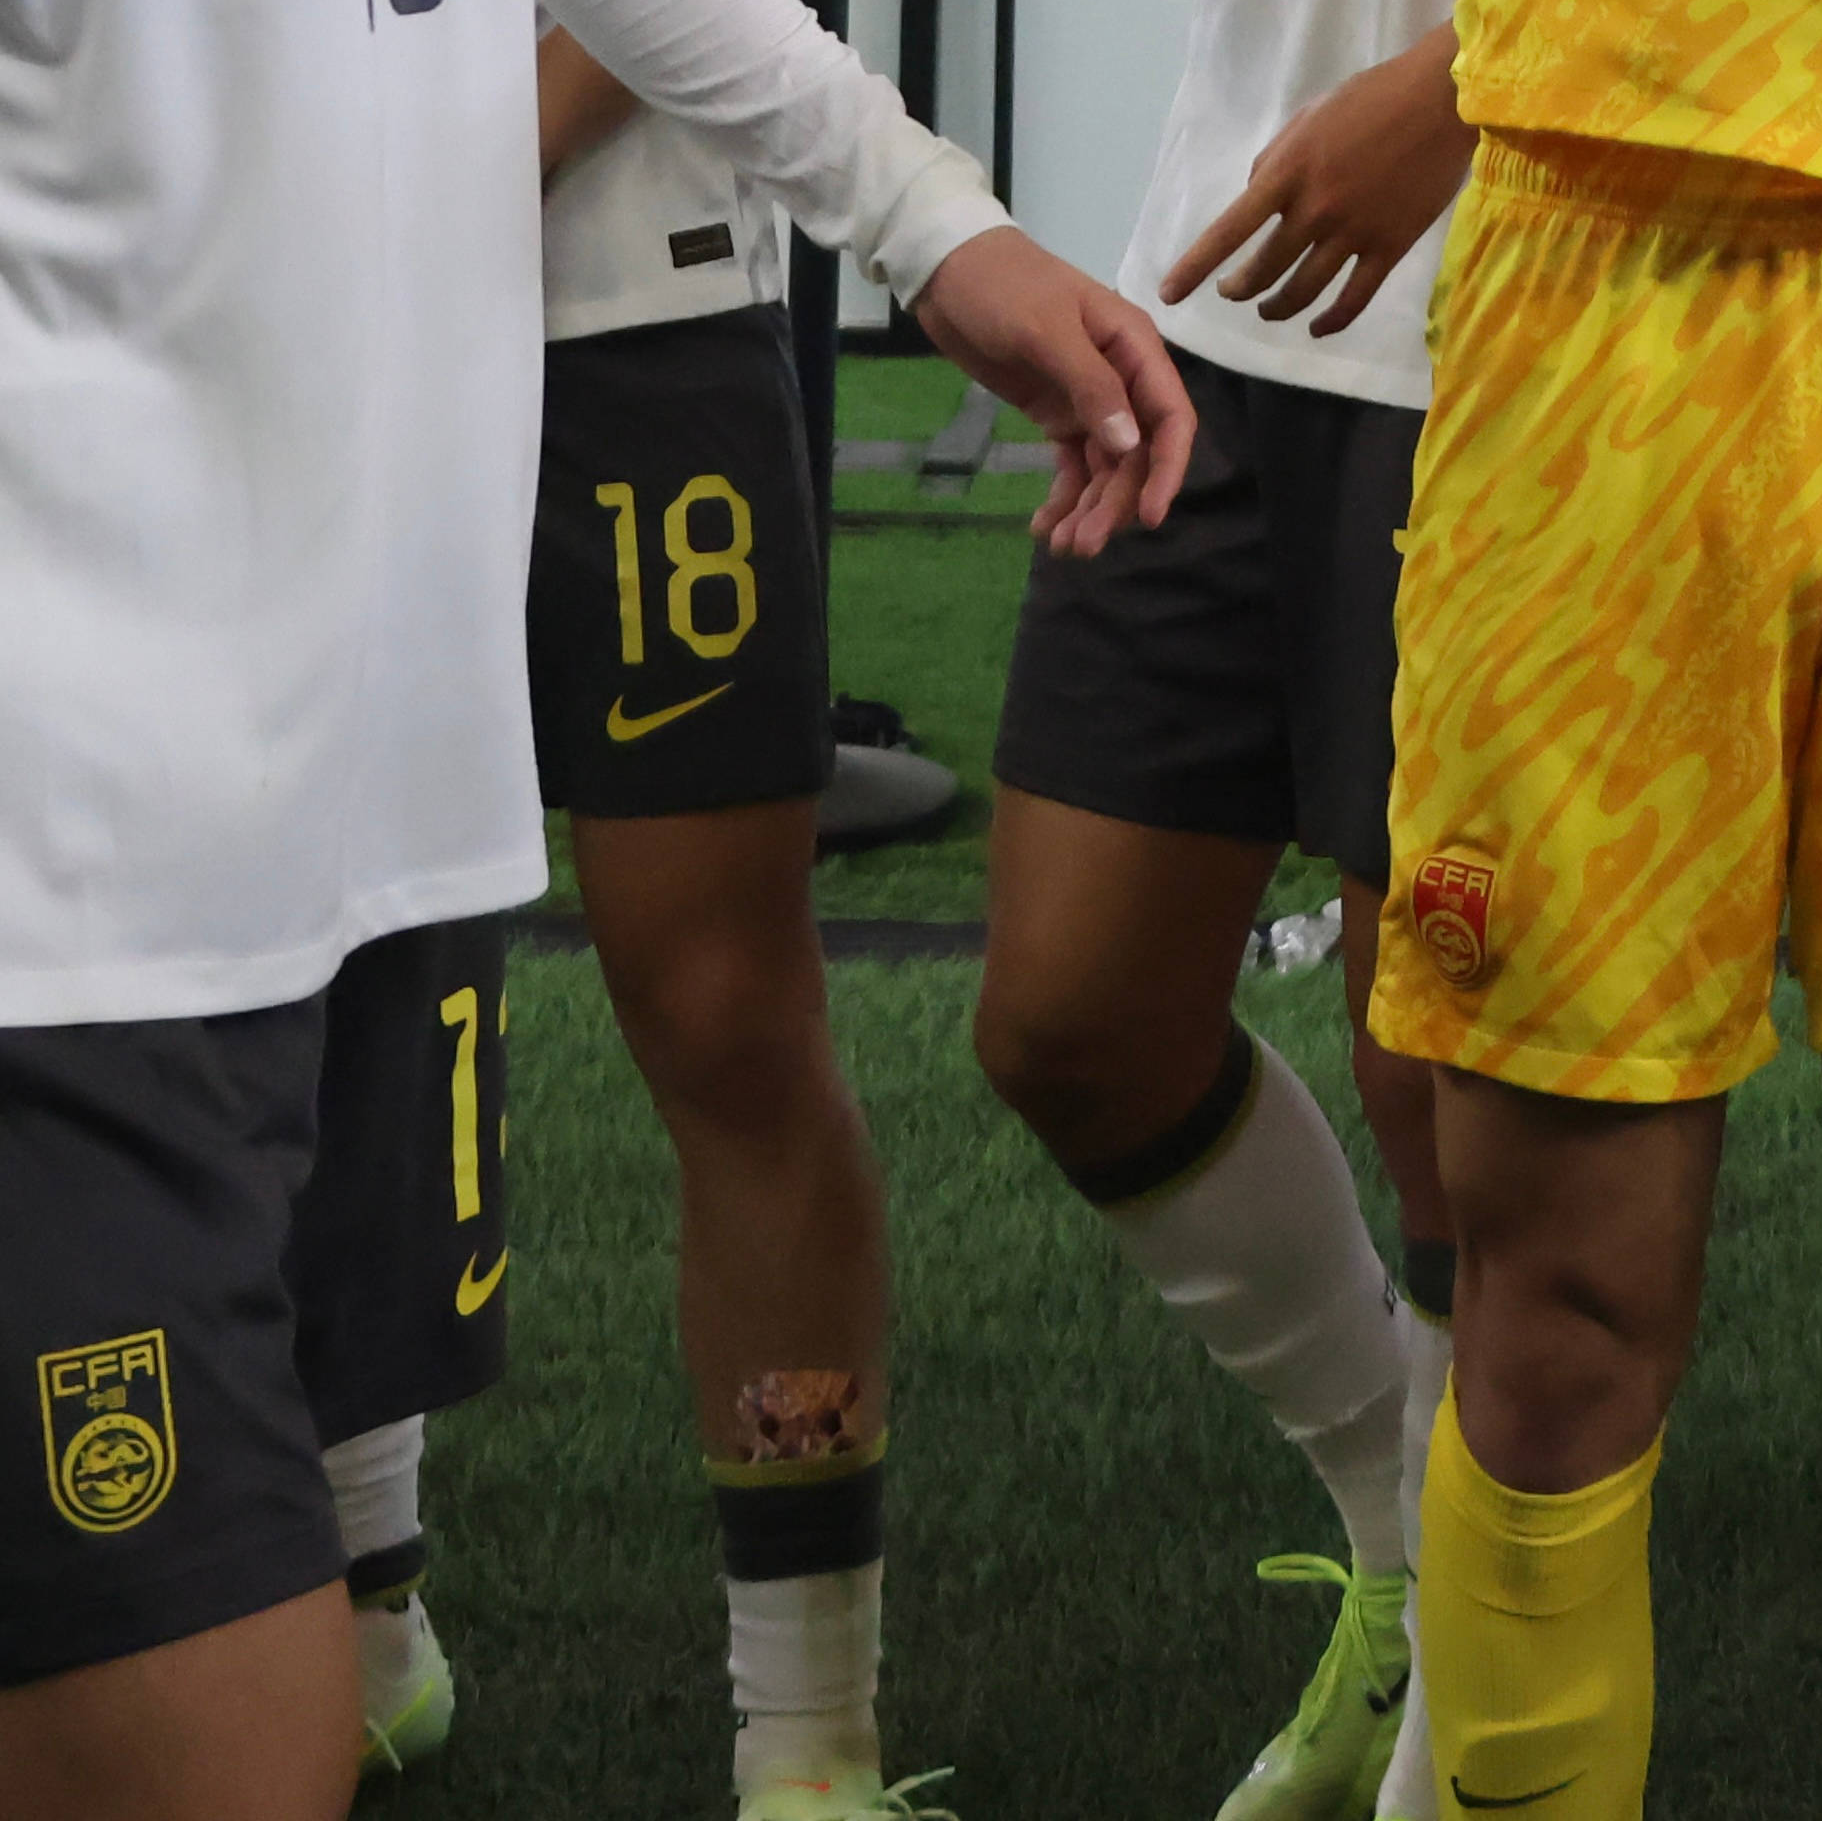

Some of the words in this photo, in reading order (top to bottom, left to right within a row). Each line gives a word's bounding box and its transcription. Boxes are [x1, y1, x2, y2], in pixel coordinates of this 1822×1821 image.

[596, 474, 757, 665] 18
[1420, 859, 1489, 898] CFA
[440, 986, 507, 1223] 1
[52, 1344, 156, 1398] CFA
